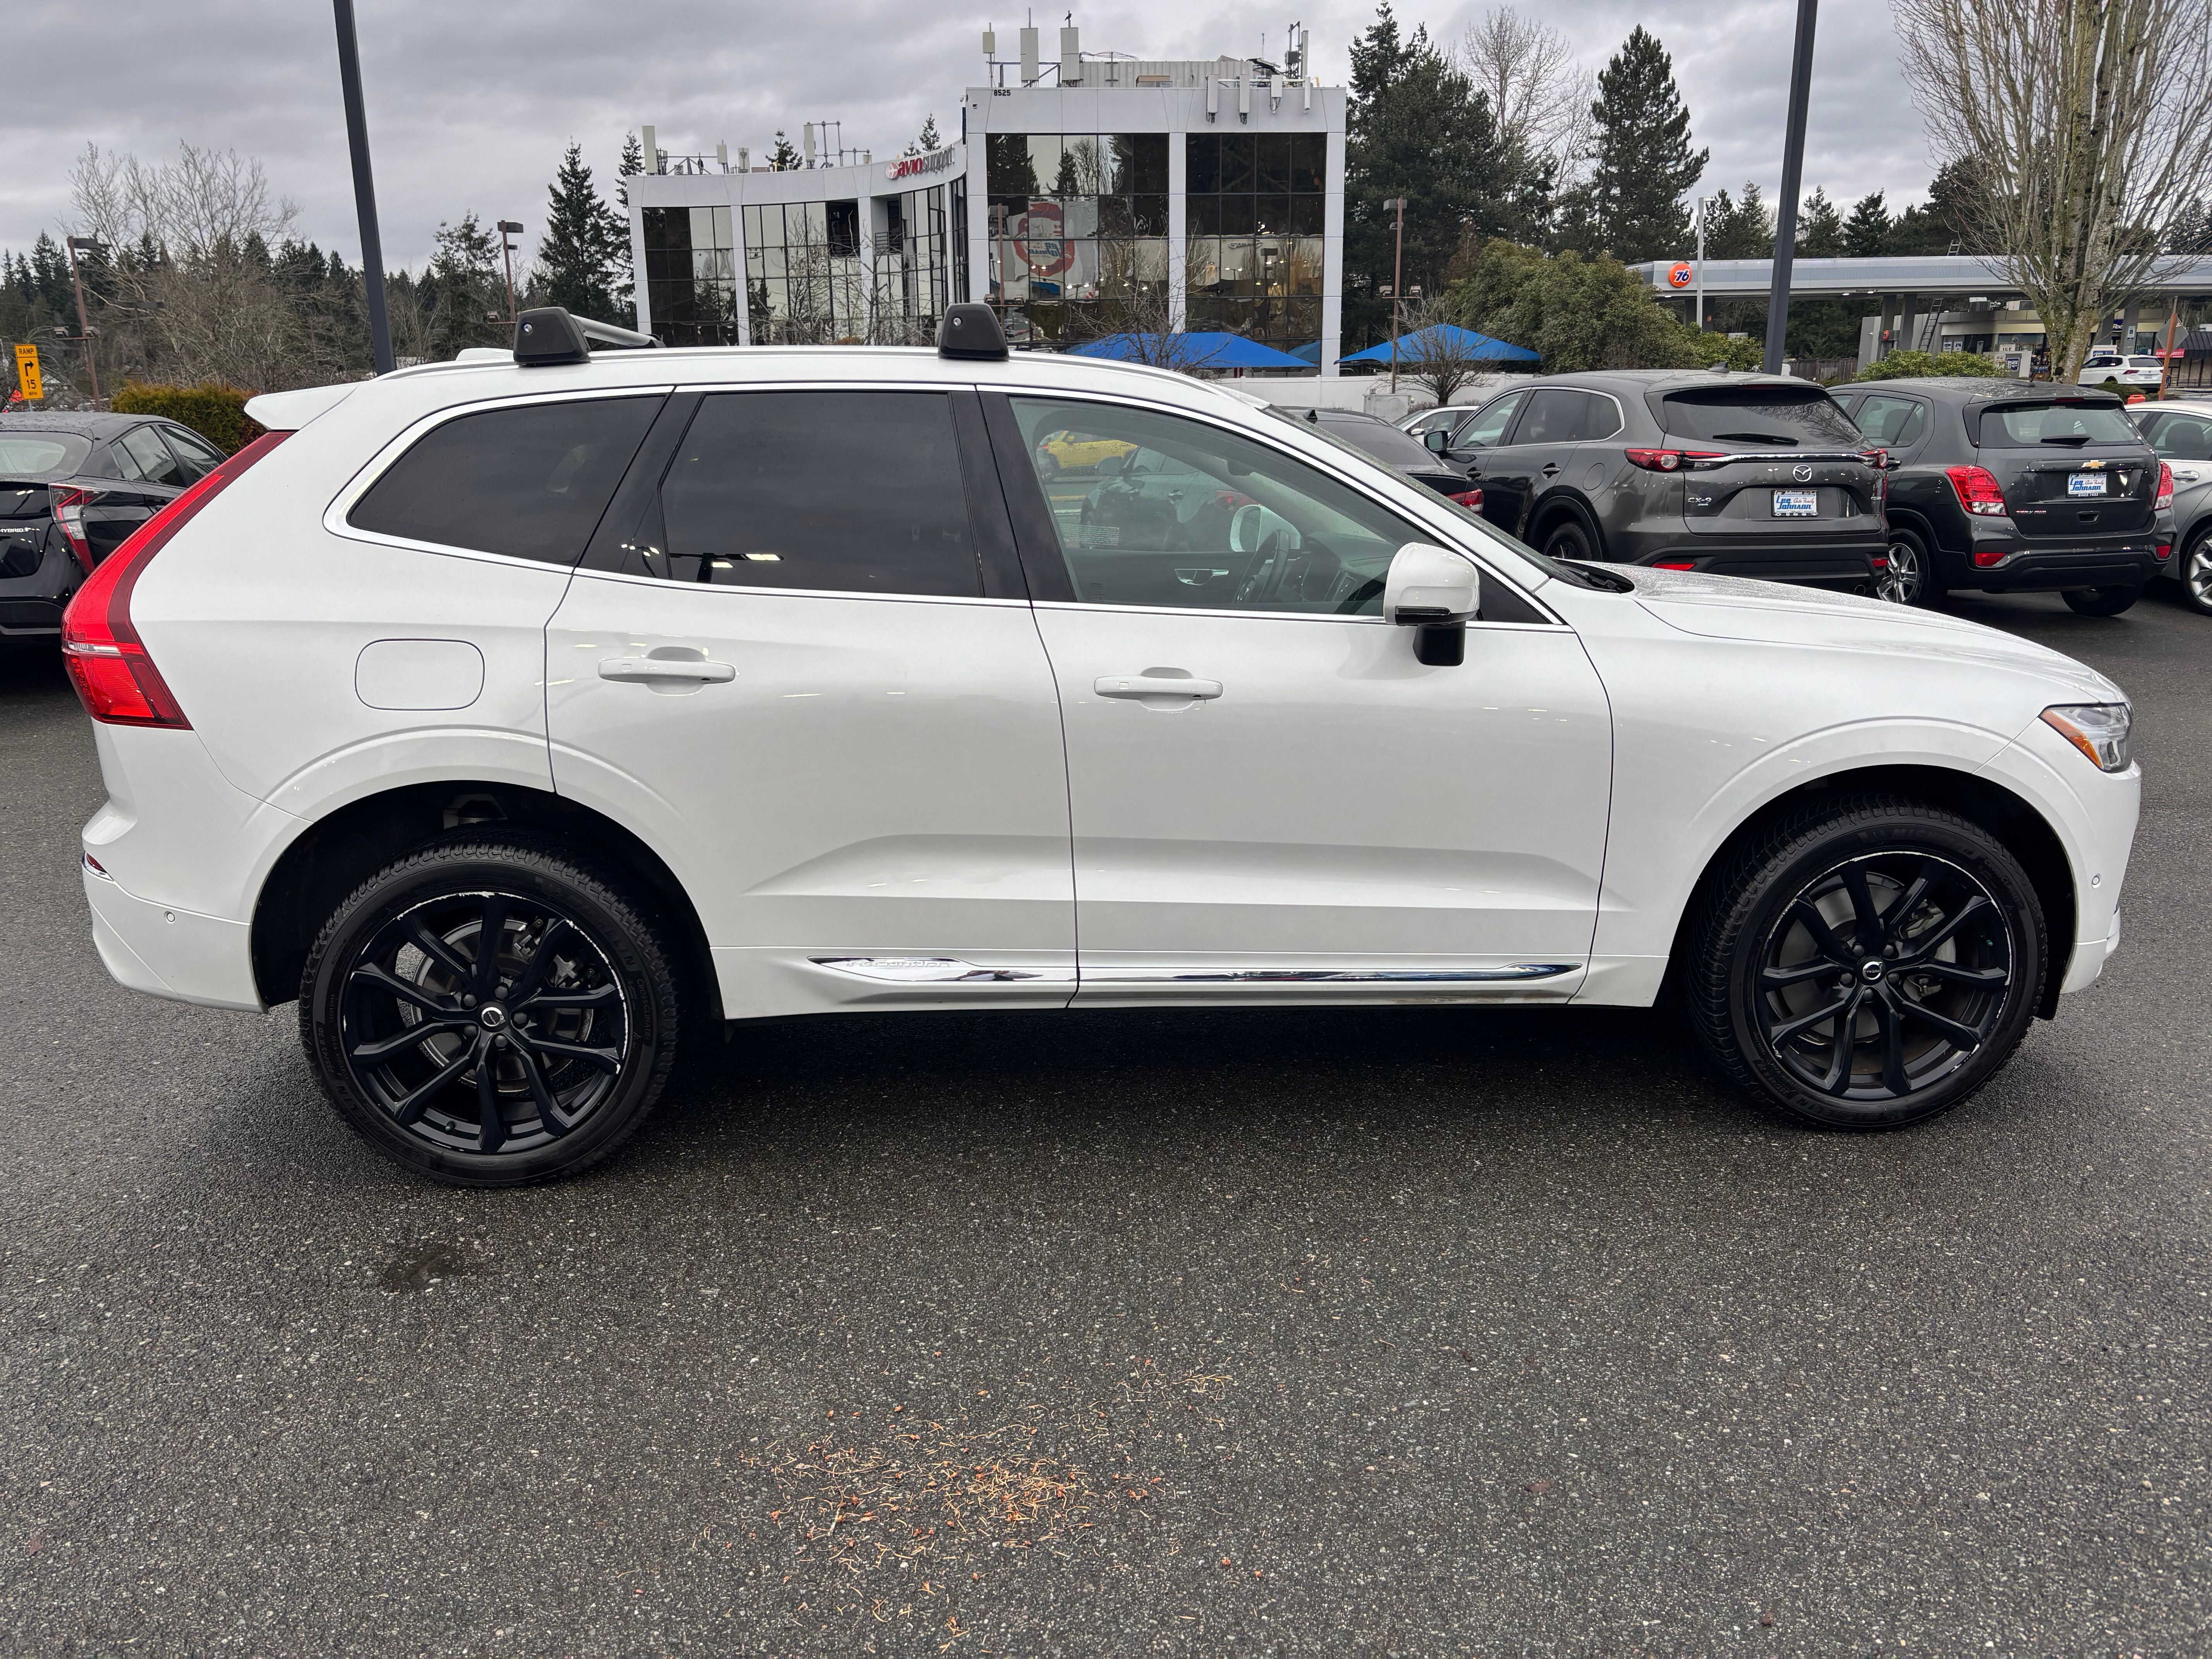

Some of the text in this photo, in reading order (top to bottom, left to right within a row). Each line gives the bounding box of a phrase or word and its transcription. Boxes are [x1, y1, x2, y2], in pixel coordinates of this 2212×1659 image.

[1674, 269, 1690, 283] 76
[27, 380, 36, 389] 15
[1776, 495, 1792, 503] Lee
